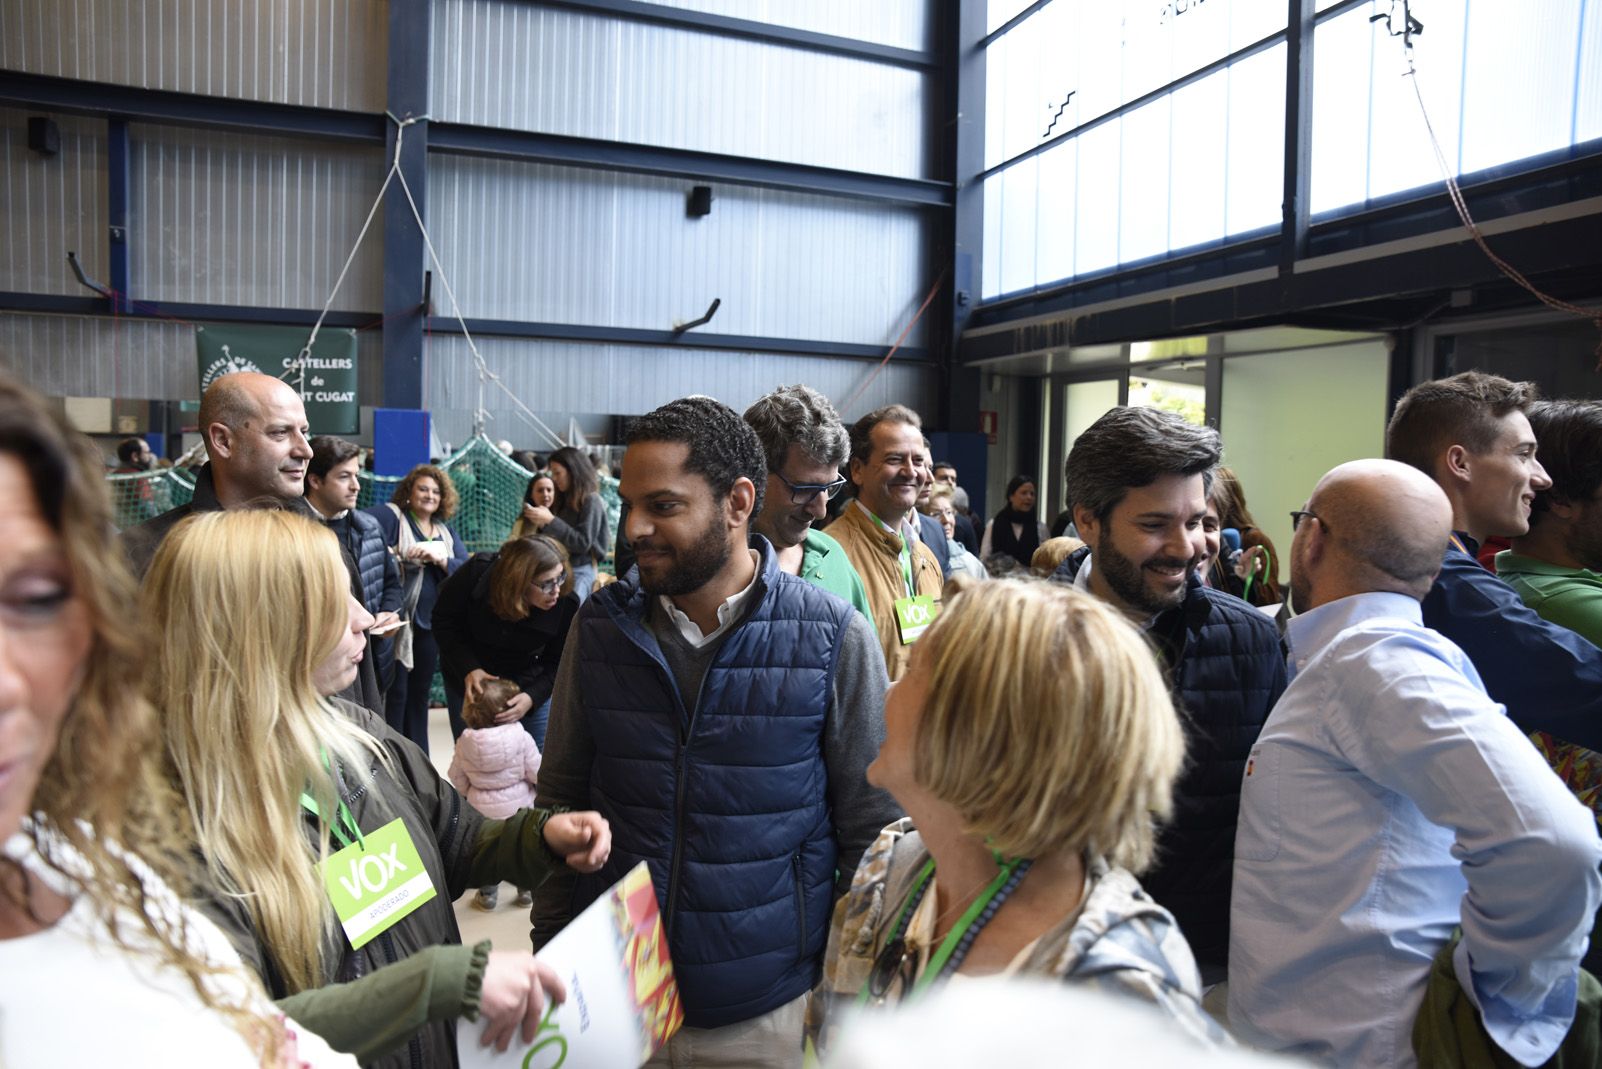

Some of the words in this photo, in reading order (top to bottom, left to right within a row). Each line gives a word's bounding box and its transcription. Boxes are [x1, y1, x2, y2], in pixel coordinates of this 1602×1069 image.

[310, 376, 325, 386] de
[315, 391, 355, 402] CUGAT
[902, 603, 931, 624] VOX
[338, 842, 408, 901] VOX
